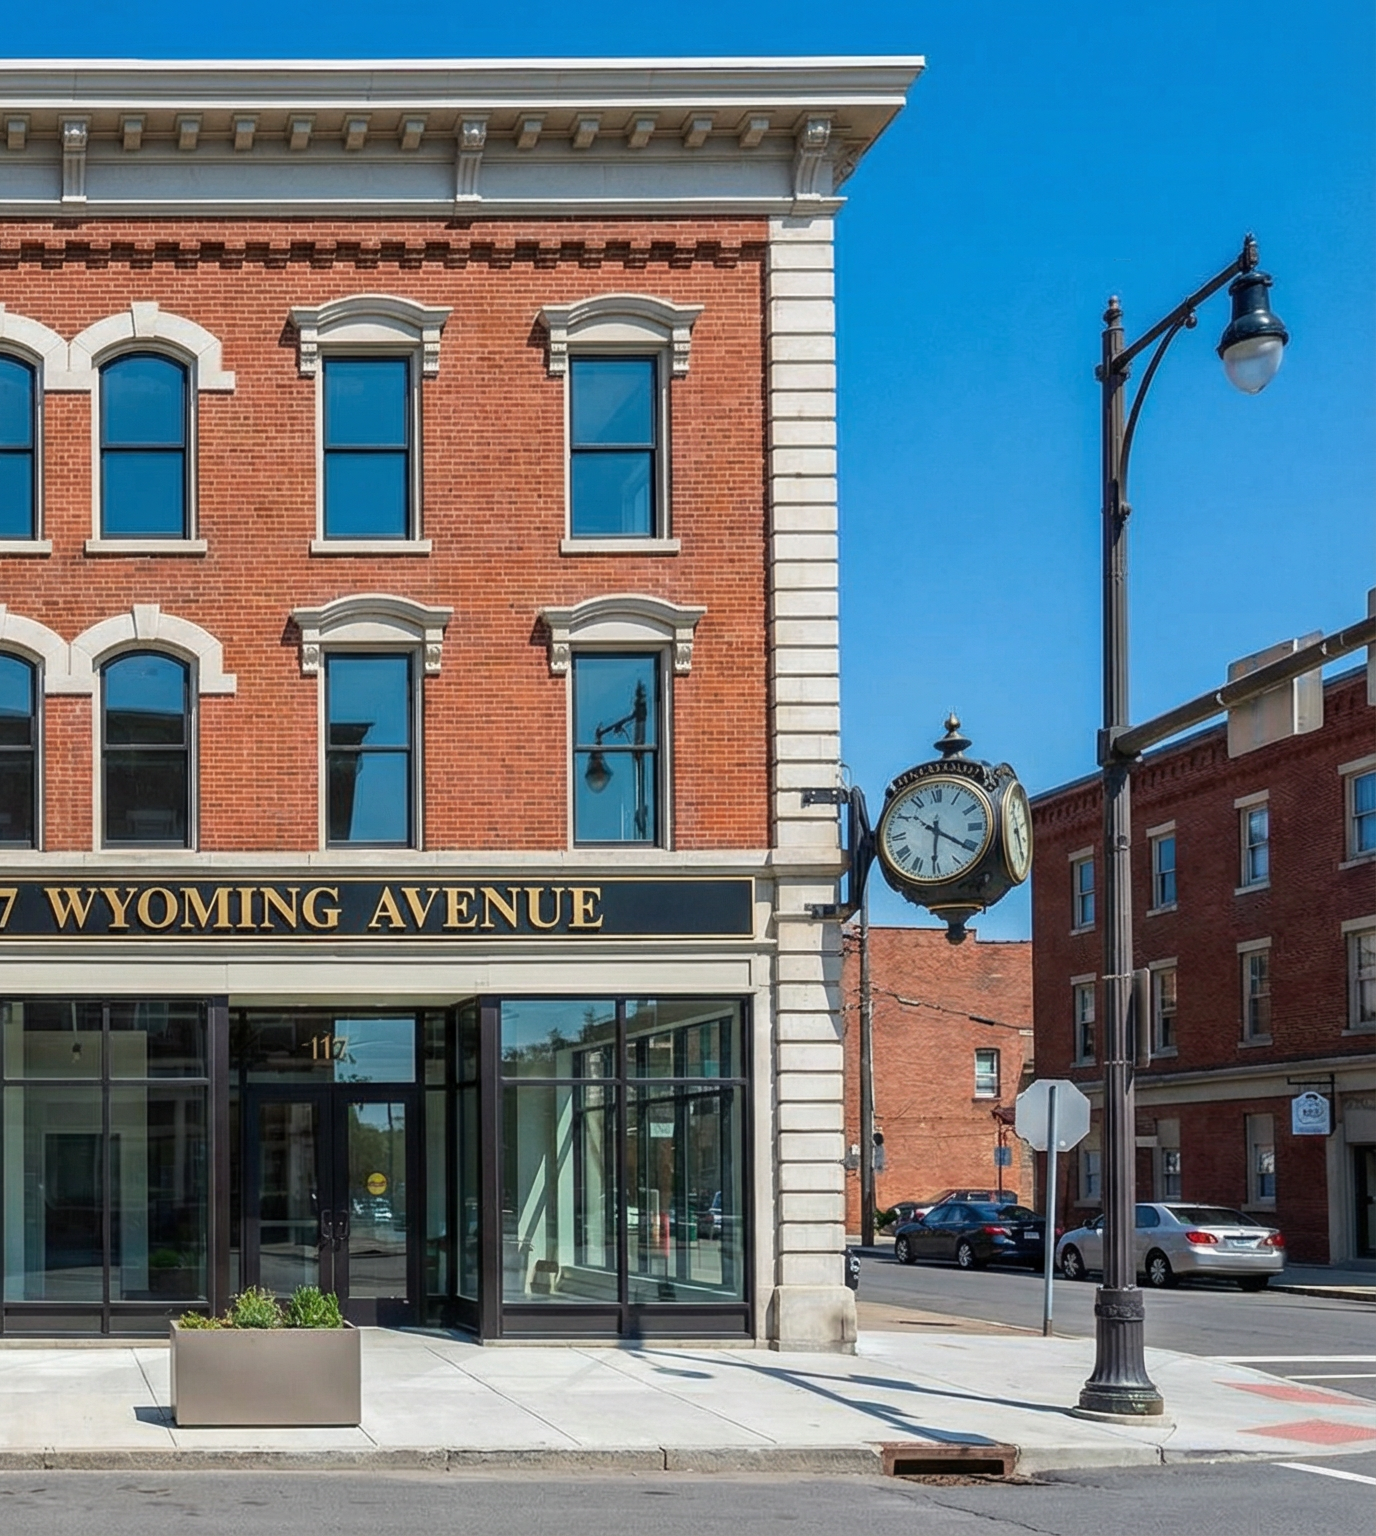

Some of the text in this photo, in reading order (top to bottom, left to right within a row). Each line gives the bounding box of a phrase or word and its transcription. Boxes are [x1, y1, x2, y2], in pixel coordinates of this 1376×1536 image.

[44, 887, 342, 928] WYOMING
[368, 886, 603, 928] AVENUE
[311, 1034, 349, 1060] 117
